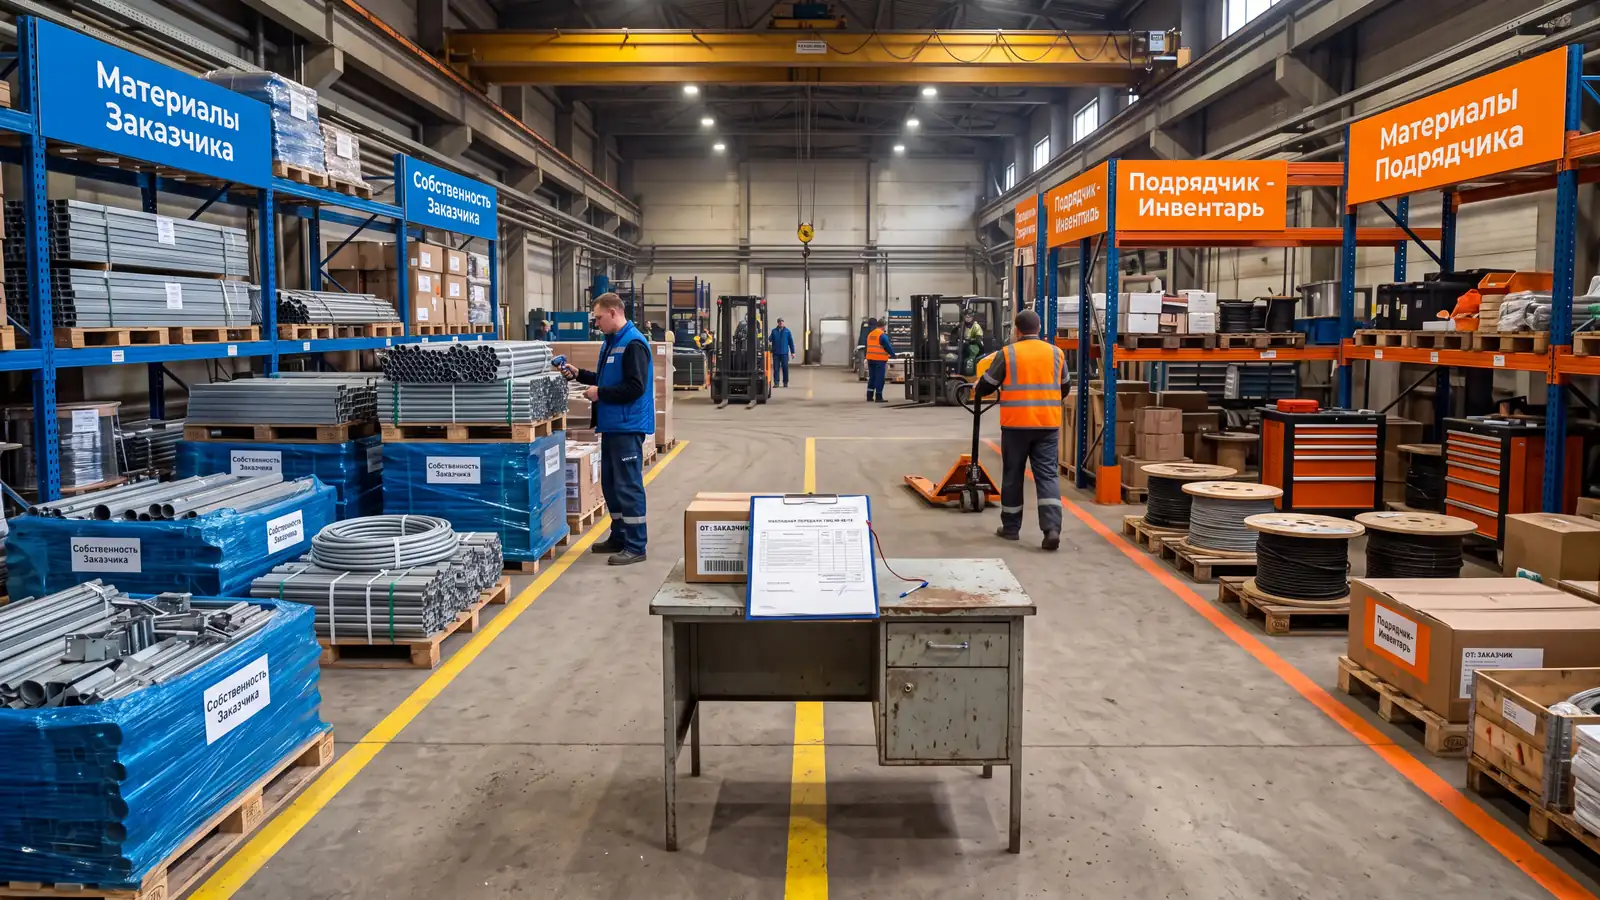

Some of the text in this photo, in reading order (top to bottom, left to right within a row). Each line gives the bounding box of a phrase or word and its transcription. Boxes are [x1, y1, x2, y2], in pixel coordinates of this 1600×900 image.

[97, 60, 240, 132] Материалы
[106, 102, 234, 162] Заказчика
[1380, 88, 1518, 151] Материалы
[1375, 124, 1524, 182] Подрядчика
[413, 170, 492, 208] Собственность
[1130, 172, 1260, 196] Подрядчик
[427, 197, 480, 226] Заказчика
[1139, 198, 1264, 221] Инвентарь
[72, 544, 138, 554] Собственность
[83, 555, 128, 564] Заказчика
[206, 670, 267, 713] Собственность
[217, 689, 260, 724] Заказчика
